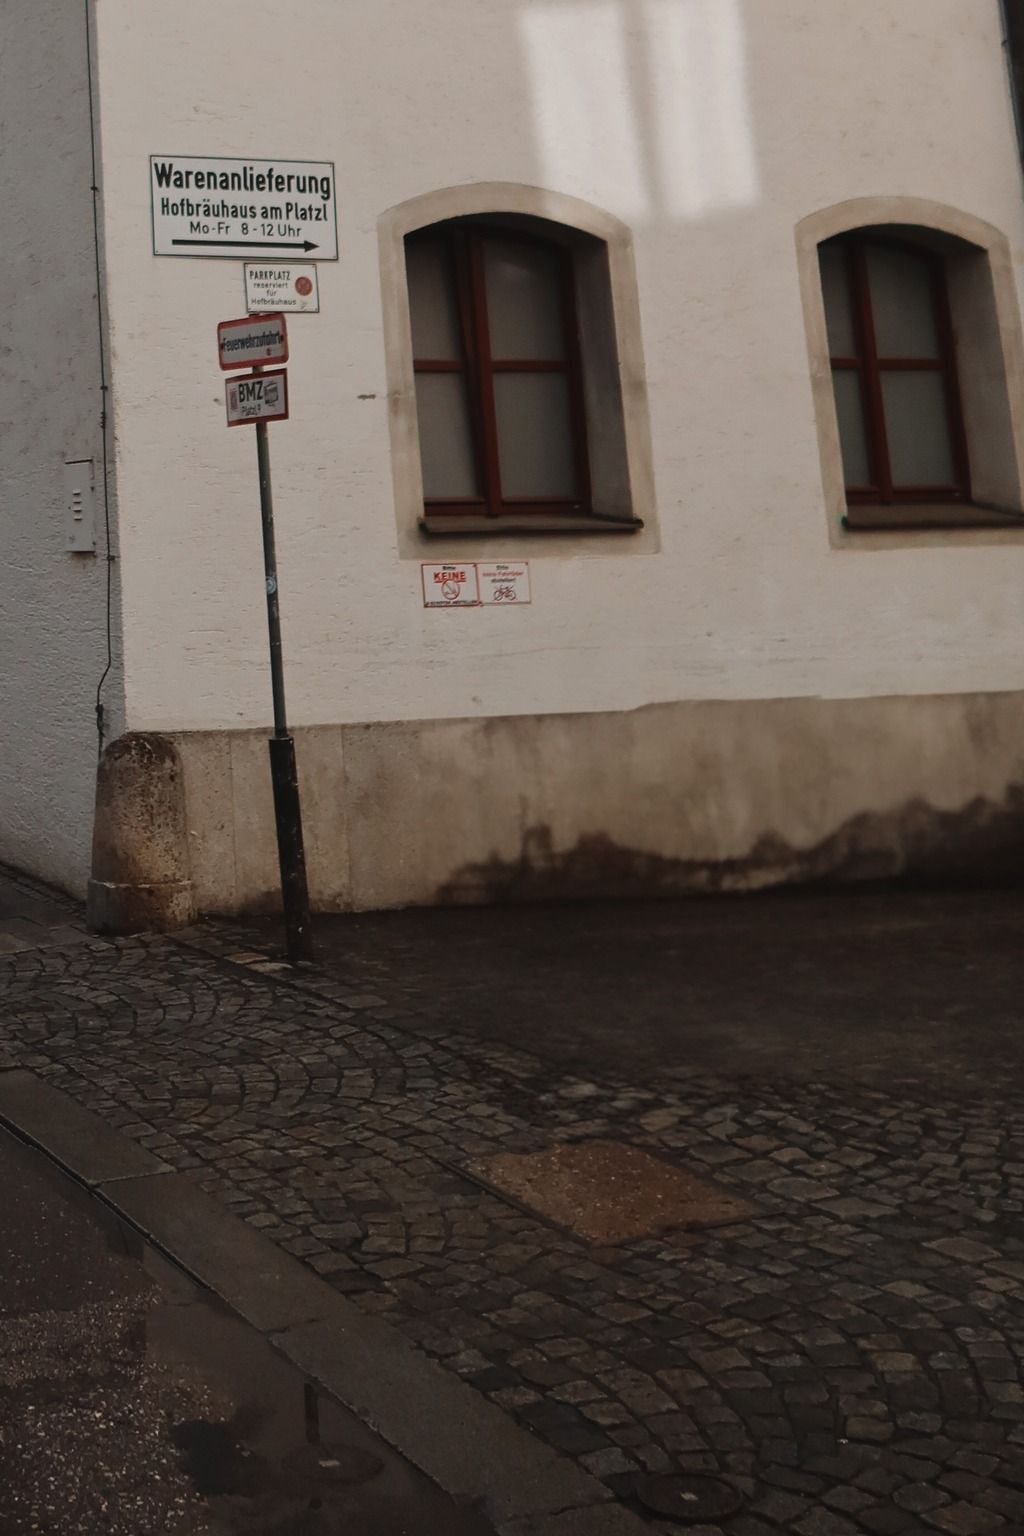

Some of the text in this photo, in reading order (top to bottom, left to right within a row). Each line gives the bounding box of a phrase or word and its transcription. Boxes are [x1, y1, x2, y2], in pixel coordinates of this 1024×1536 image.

[154, 162, 331, 201] Warenanlieferung
[161, 197, 328, 222] Hofbräuhaus am Platzl
[241, 222, 249, 236] 8
[261, 223, 274, 237] 12
[277, 223, 302, 237] Uhr
[249, 270, 291, 281] PARKPLATZ
[238, 380, 264, 403] BMZ
[433, 571, 466, 581] KEINE
